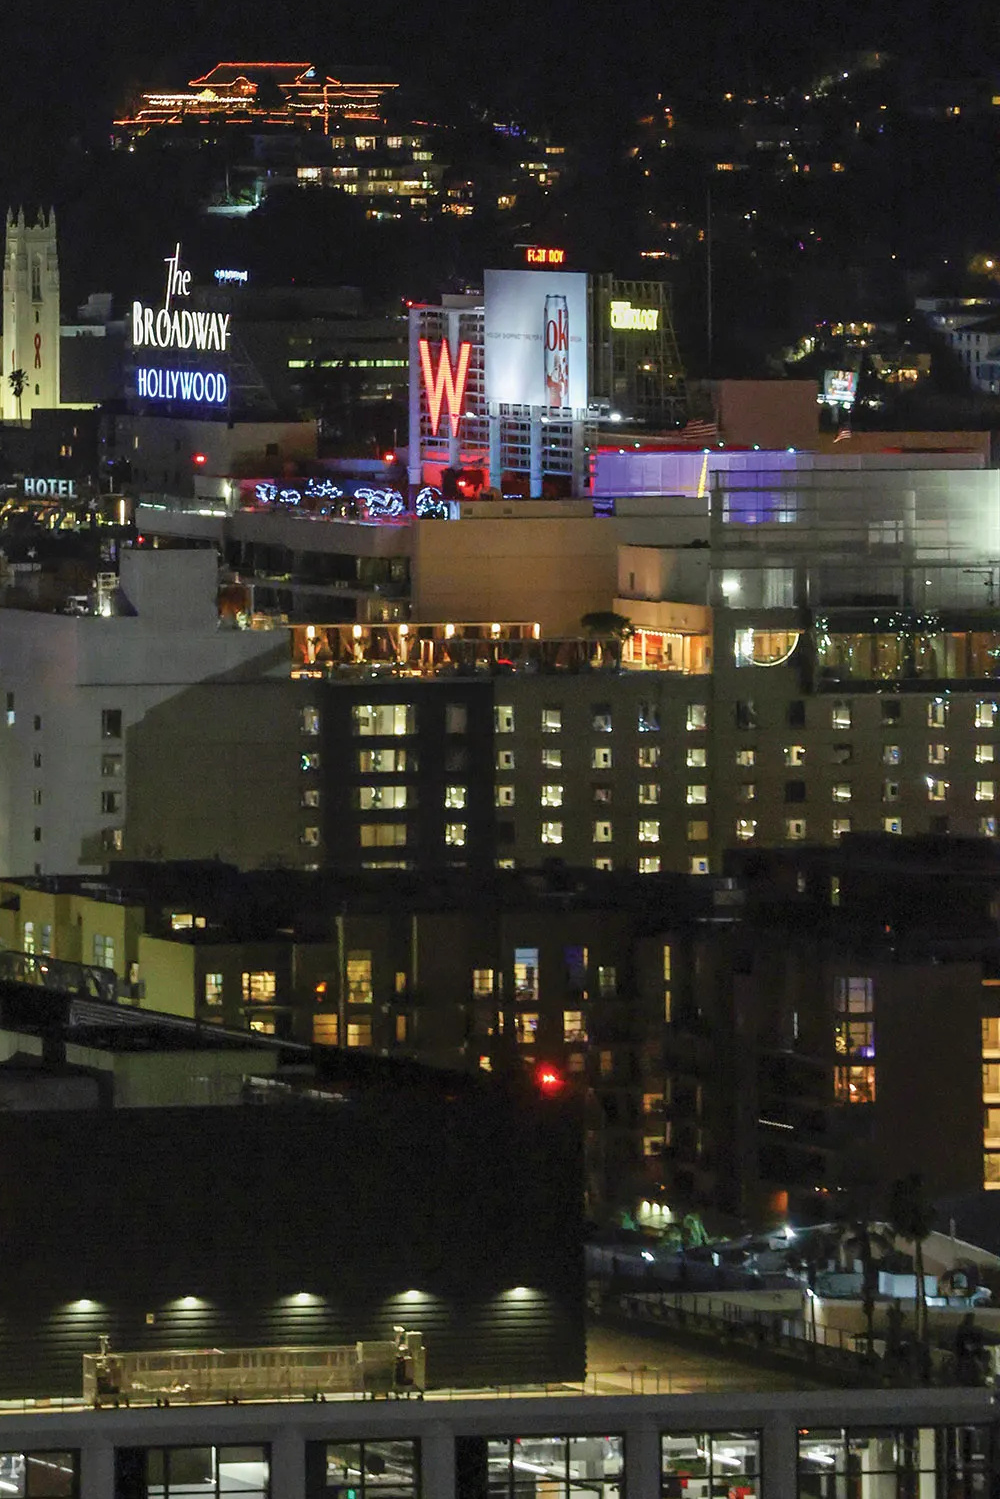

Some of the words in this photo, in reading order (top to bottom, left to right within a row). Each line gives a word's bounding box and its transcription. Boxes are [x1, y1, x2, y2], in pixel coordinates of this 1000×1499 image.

[164, 242, 192, 328] The
[132, 301, 231, 351] BROADWAY
[138, 368, 227, 403] HOLLYWOOD
[418, 337, 472, 438] W
[24, 478, 78, 498] HOTEL
